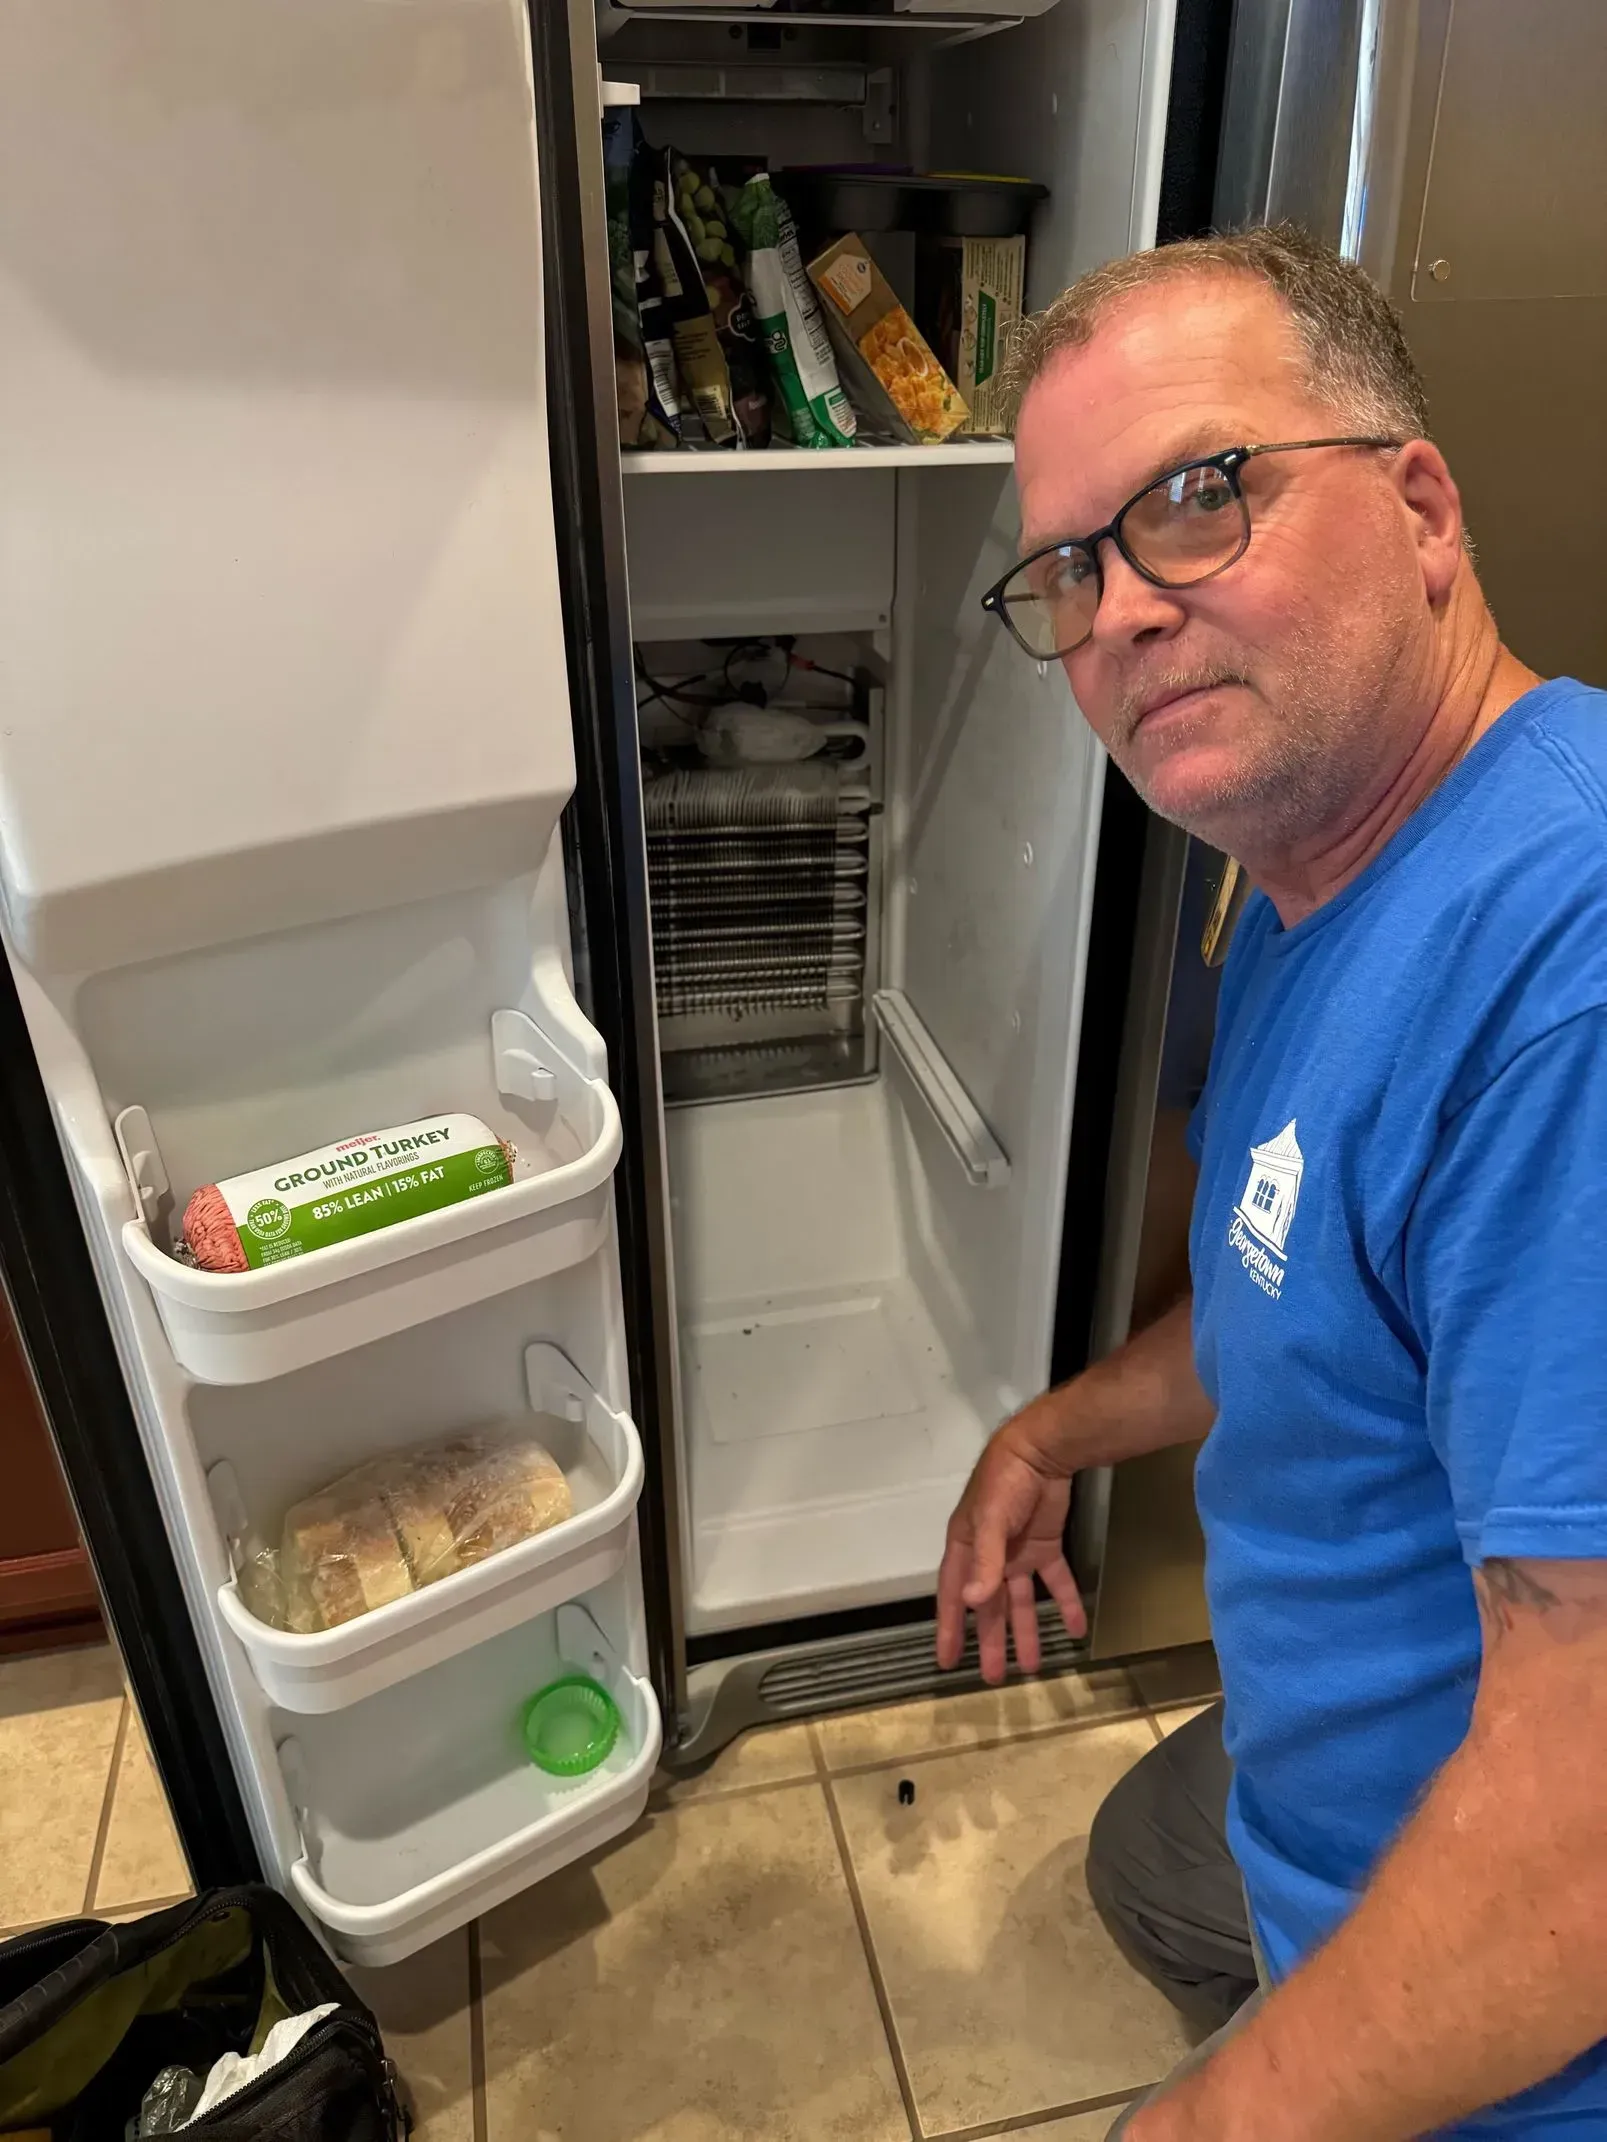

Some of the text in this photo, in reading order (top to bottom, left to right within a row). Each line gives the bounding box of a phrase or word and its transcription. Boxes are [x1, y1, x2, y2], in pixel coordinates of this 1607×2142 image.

[274, 1128, 450, 1192] GROUND TURKEY
[322, 1152, 420, 1189] WITH NATURAL FLAVORINGS
[312, 1200, 344, 1220] 85%
[344, 1186, 384, 1209] LEAN
[392, 1175, 419, 1193] 15%
[420, 1166, 445, 1184] FAT
[469, 1174, 504, 1192] KEEP FROZEN
[251, 1203, 263, 1213] LESS
[255, 1208, 283, 1227] 50%
[1228, 1217, 1285, 1287] Georgetown
[1249, 1267, 1282, 1300] KENTUCKY
